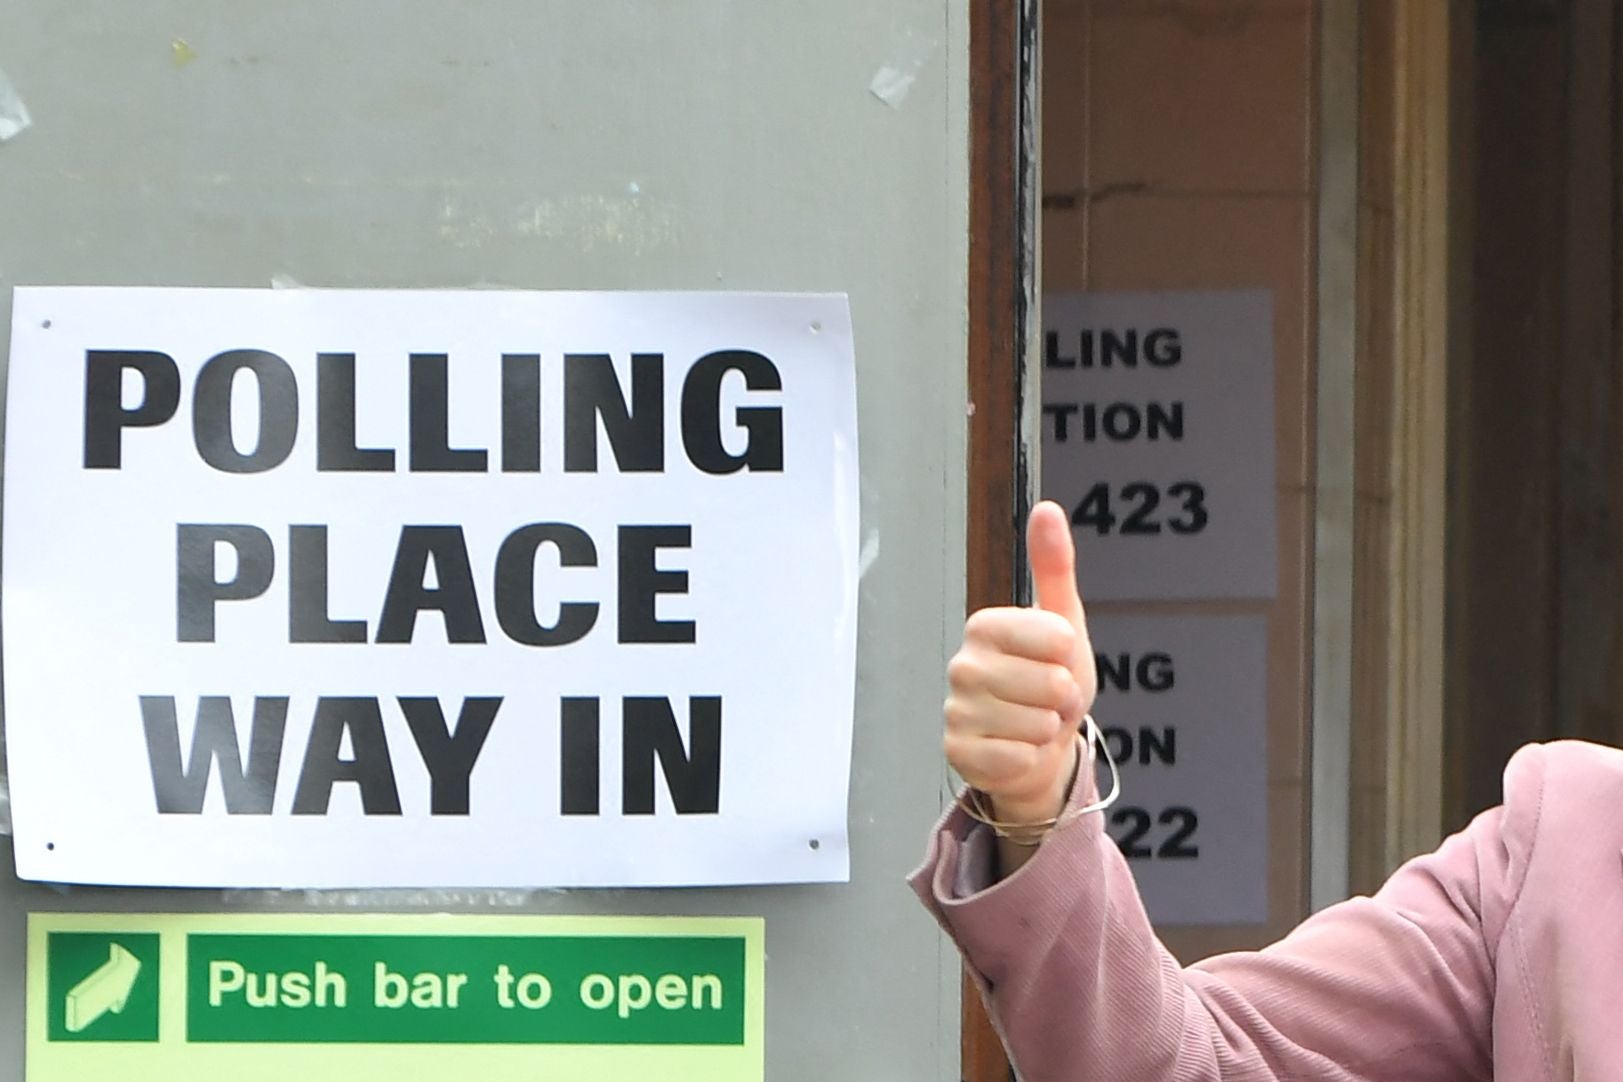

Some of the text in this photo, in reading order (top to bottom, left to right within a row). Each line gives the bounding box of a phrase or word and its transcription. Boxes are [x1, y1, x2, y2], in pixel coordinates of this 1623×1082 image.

[1044, 327, 1182, 368] LING
[82, 348, 785, 476] POLLING
[1042, 402, 1184, 442] TION
[1070, 480, 1209, 536] 423
[175, 521, 698, 649] PLACE
[1096, 652, 1175, 692] NG
[140, 695, 724, 817] WAY IN
[1096, 726, 1177, 767] ON
[1111, 806, 1200, 858] 22
[208, 959, 724, 1020] Push bar to open
